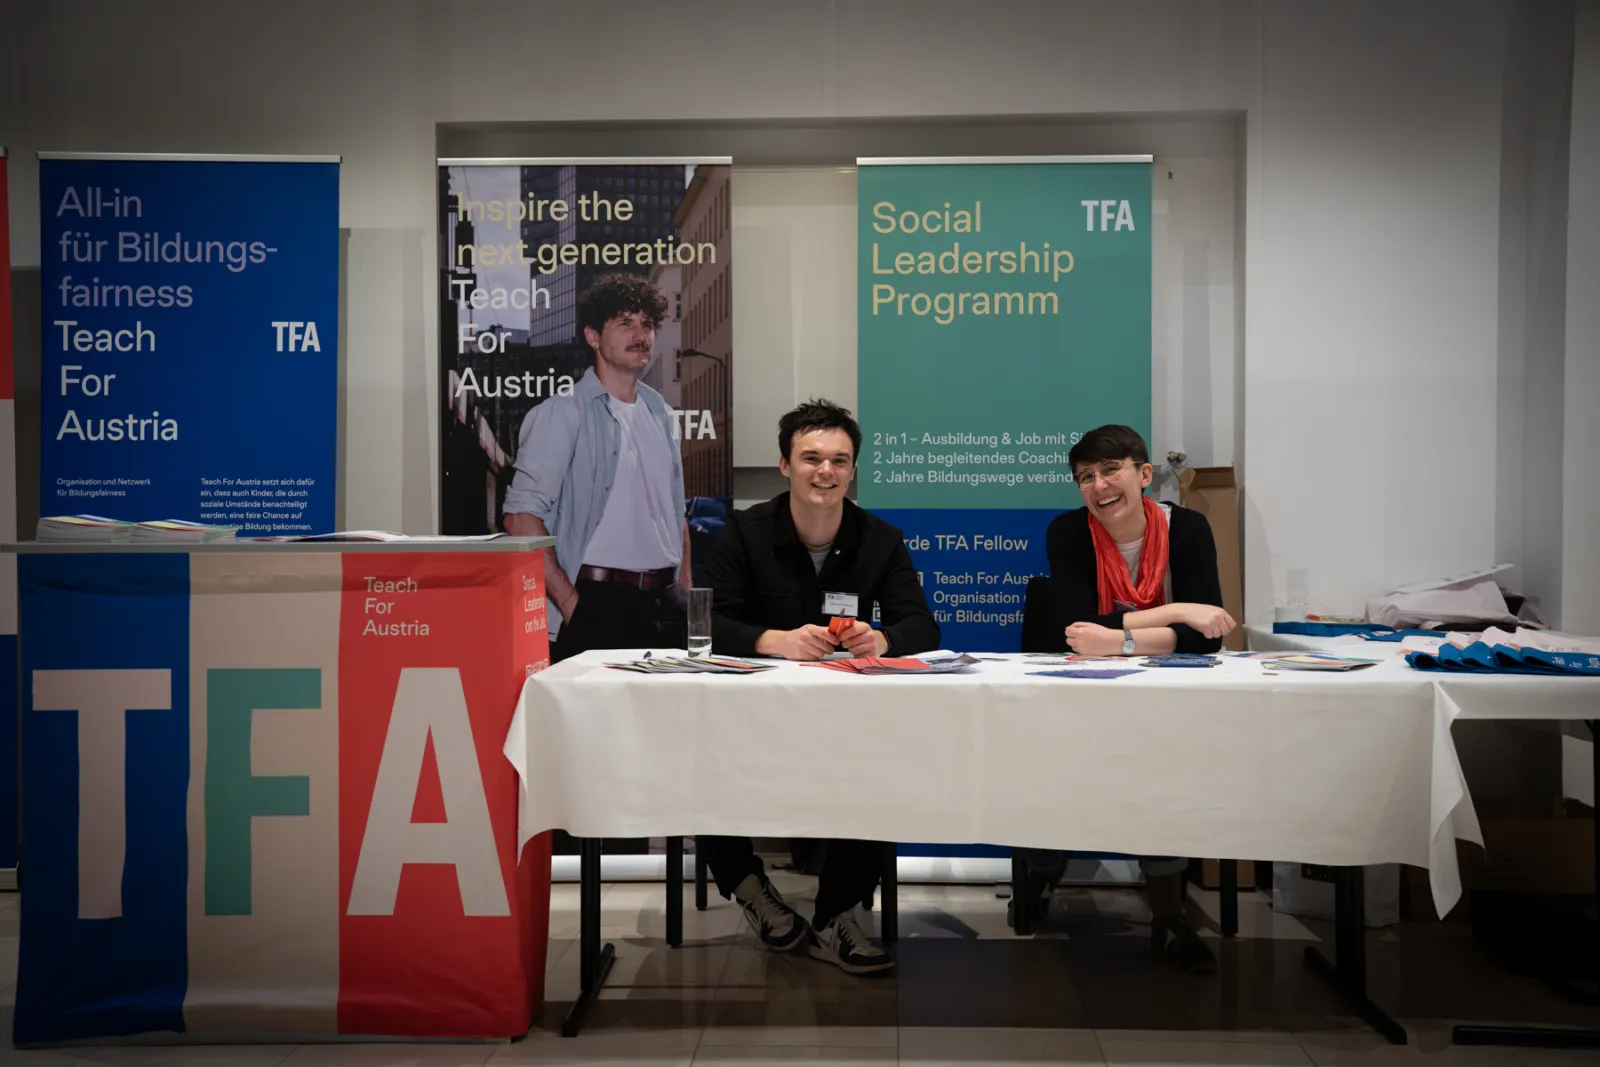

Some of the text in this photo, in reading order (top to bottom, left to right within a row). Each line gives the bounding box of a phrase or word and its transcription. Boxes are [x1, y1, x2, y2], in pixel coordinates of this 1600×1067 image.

[57, 187, 142, 218] All-in
[457, 191, 634, 228] Inspire the
[872, 201, 981, 234] Social
[1081, 200, 1135, 232] TFA
[59, 231, 278, 273] für Bildungs-
[458, 235, 716, 274] next generation
[873, 242, 1074, 282] Leadership
[59, 276, 194, 308] fairness
[452, 279, 550, 310] Teach
[873, 284, 1059, 325] Programm
[54, 320, 156, 352] Teach
[271, 321, 321, 352] TFA
[458, 324, 512, 354] For
[61, 366, 116, 396] For
[455, 368, 574, 398] Austria
[56, 410, 179, 441] Austria
[668, 410, 716, 440] TFA
[873, 433, 882, 445] 2
[885, 433, 897, 445] in
[901, 433, 906, 444] 1
[922, 432, 998, 448] Ausbildung
[1001, 433, 1012, 445] &
[1015, 432, 1041, 444] Job
[1044, 432, 1066, 444] mit
[873, 452, 882, 464] 2
[886, 452, 924, 464] Jahre
[928, 452, 1015, 467] begleitendes
[57, 478, 101, 487] Organisation
[201, 478, 220, 486] Teach
[236, 478, 260, 486] Austria
[873, 471, 882, 483] 2
[886, 471, 924, 484] Jahre
[928, 470, 1024, 486] Bildungswege
[69, 489, 126, 498] Bildungsfairness
[251, 490, 274, 498] Kinder,
[262, 501, 308, 510] benachteiligt
[245, 522, 271, 532] Bildung
[934, 535, 968, 550] TFA
[974, 535, 1028, 550] Fellow
[364, 577, 418, 592] Teach
[934, 572, 972, 584] Teach
[977, 572, 998, 584] For
[365, 598, 395, 614] For
[934, 591, 1020, 606] Organisation
[362, 620, 430, 636] Austria
[934, 610, 952, 623] für
[32, 667, 512, 919] TFA
